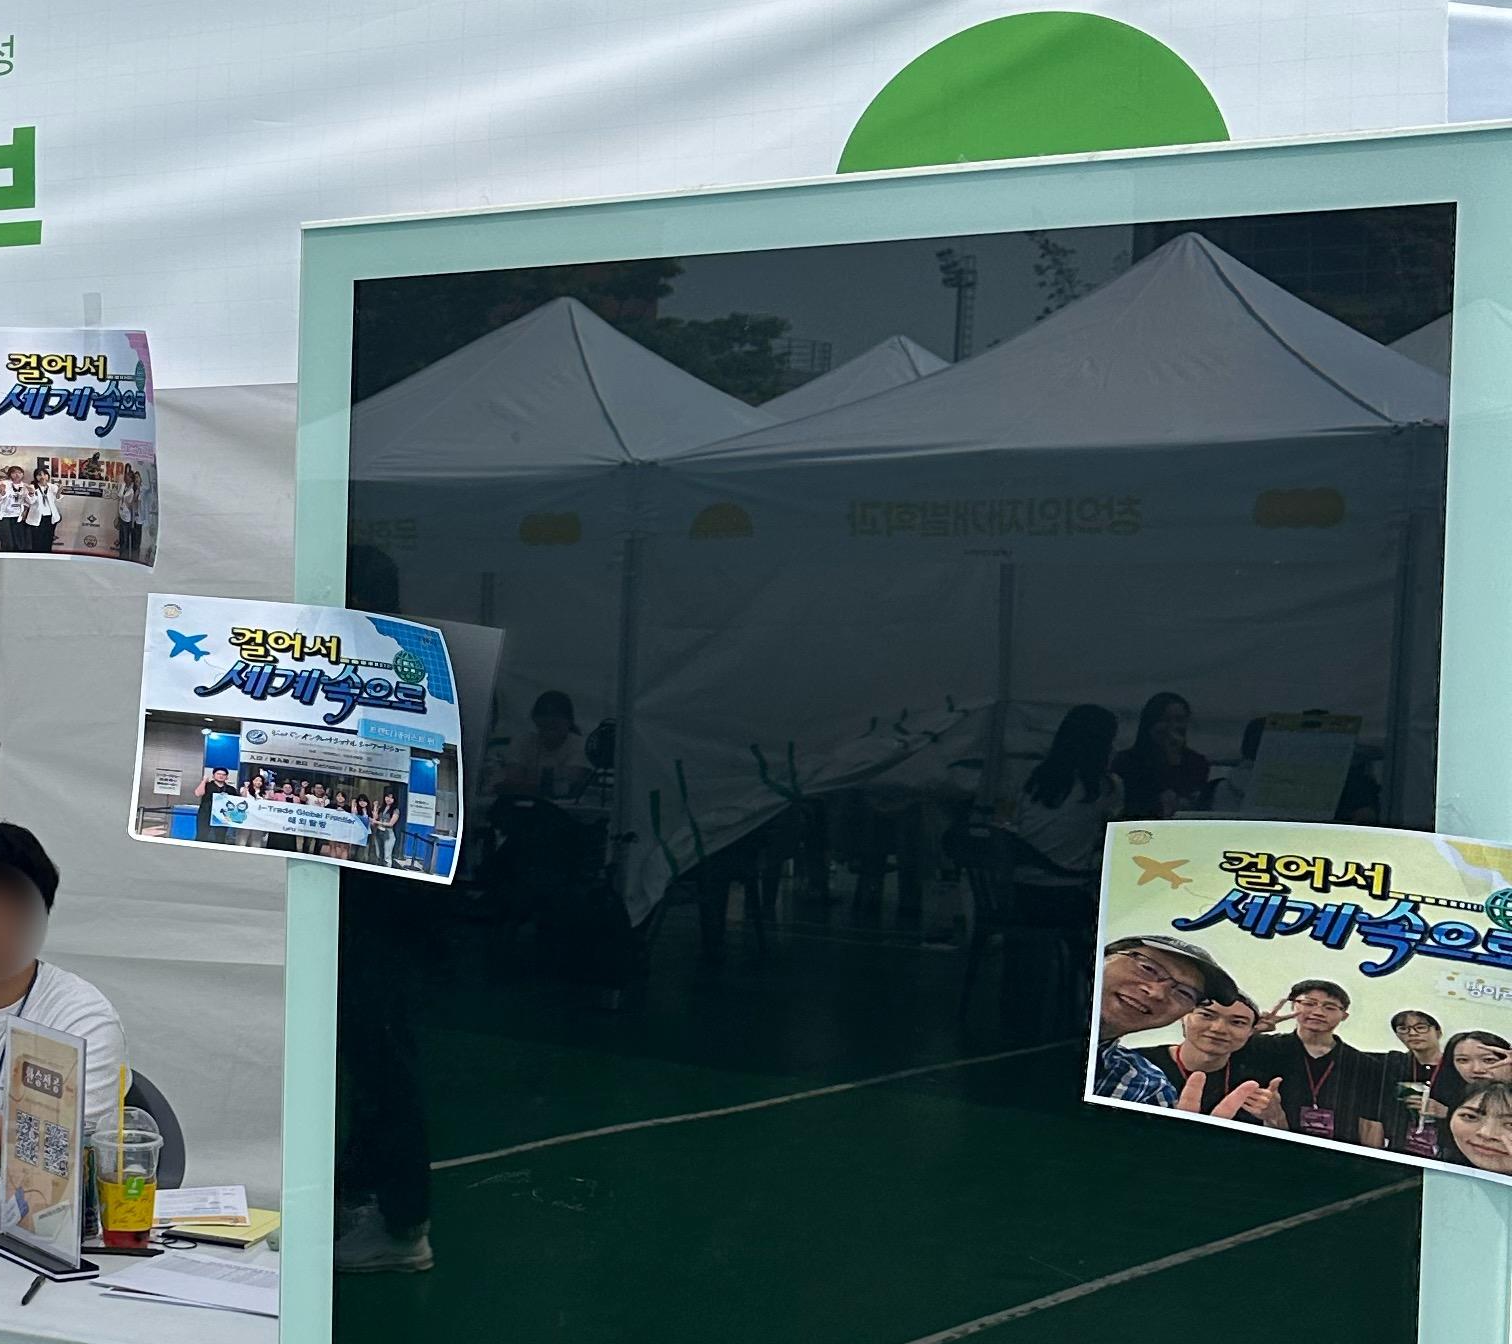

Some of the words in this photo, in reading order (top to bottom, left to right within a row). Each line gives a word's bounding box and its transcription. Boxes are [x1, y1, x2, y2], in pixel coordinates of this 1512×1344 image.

[6, 353, 108, 386] 걸어서
[229, 626, 341, 662] 걸어서
[194, 660, 428, 725] 세계속으로
[1219, 851, 1390, 900] 걸어서
